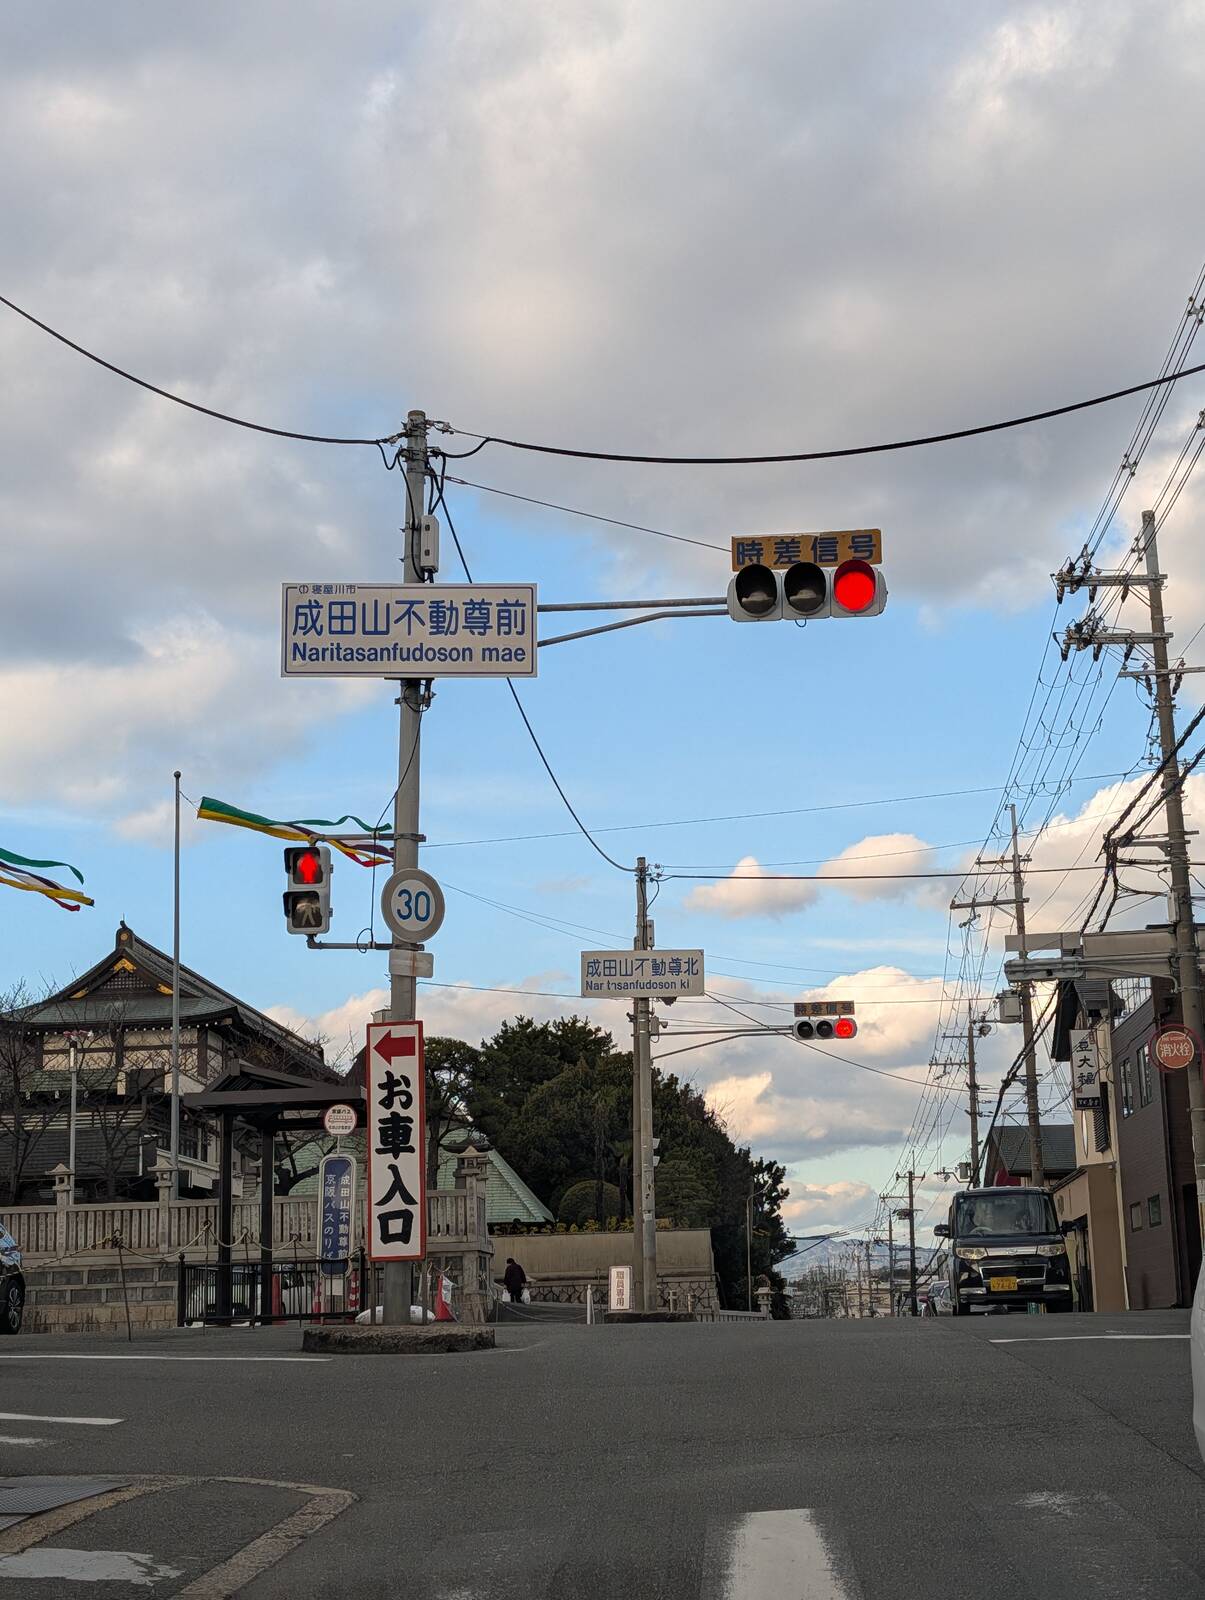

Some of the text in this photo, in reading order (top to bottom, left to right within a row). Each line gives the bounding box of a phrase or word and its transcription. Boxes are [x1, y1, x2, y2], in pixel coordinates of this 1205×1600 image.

[736, 534, 876, 565] 時差信号
[311, 584, 356, 595] 寝屋川市
[292, 598, 527, 636] 成田山不動尊前
[292, 642, 526, 662] Naritasanfudoson mae
[397, 888, 431, 921] 30
[586, 957, 699, 977] 成田山不動尊北
[585, 979, 677, 991] Nartsanfudoson
[1160, 1042, 1190, 1057] 消火栓
[374, 1070, 418, 1245] お車入口
